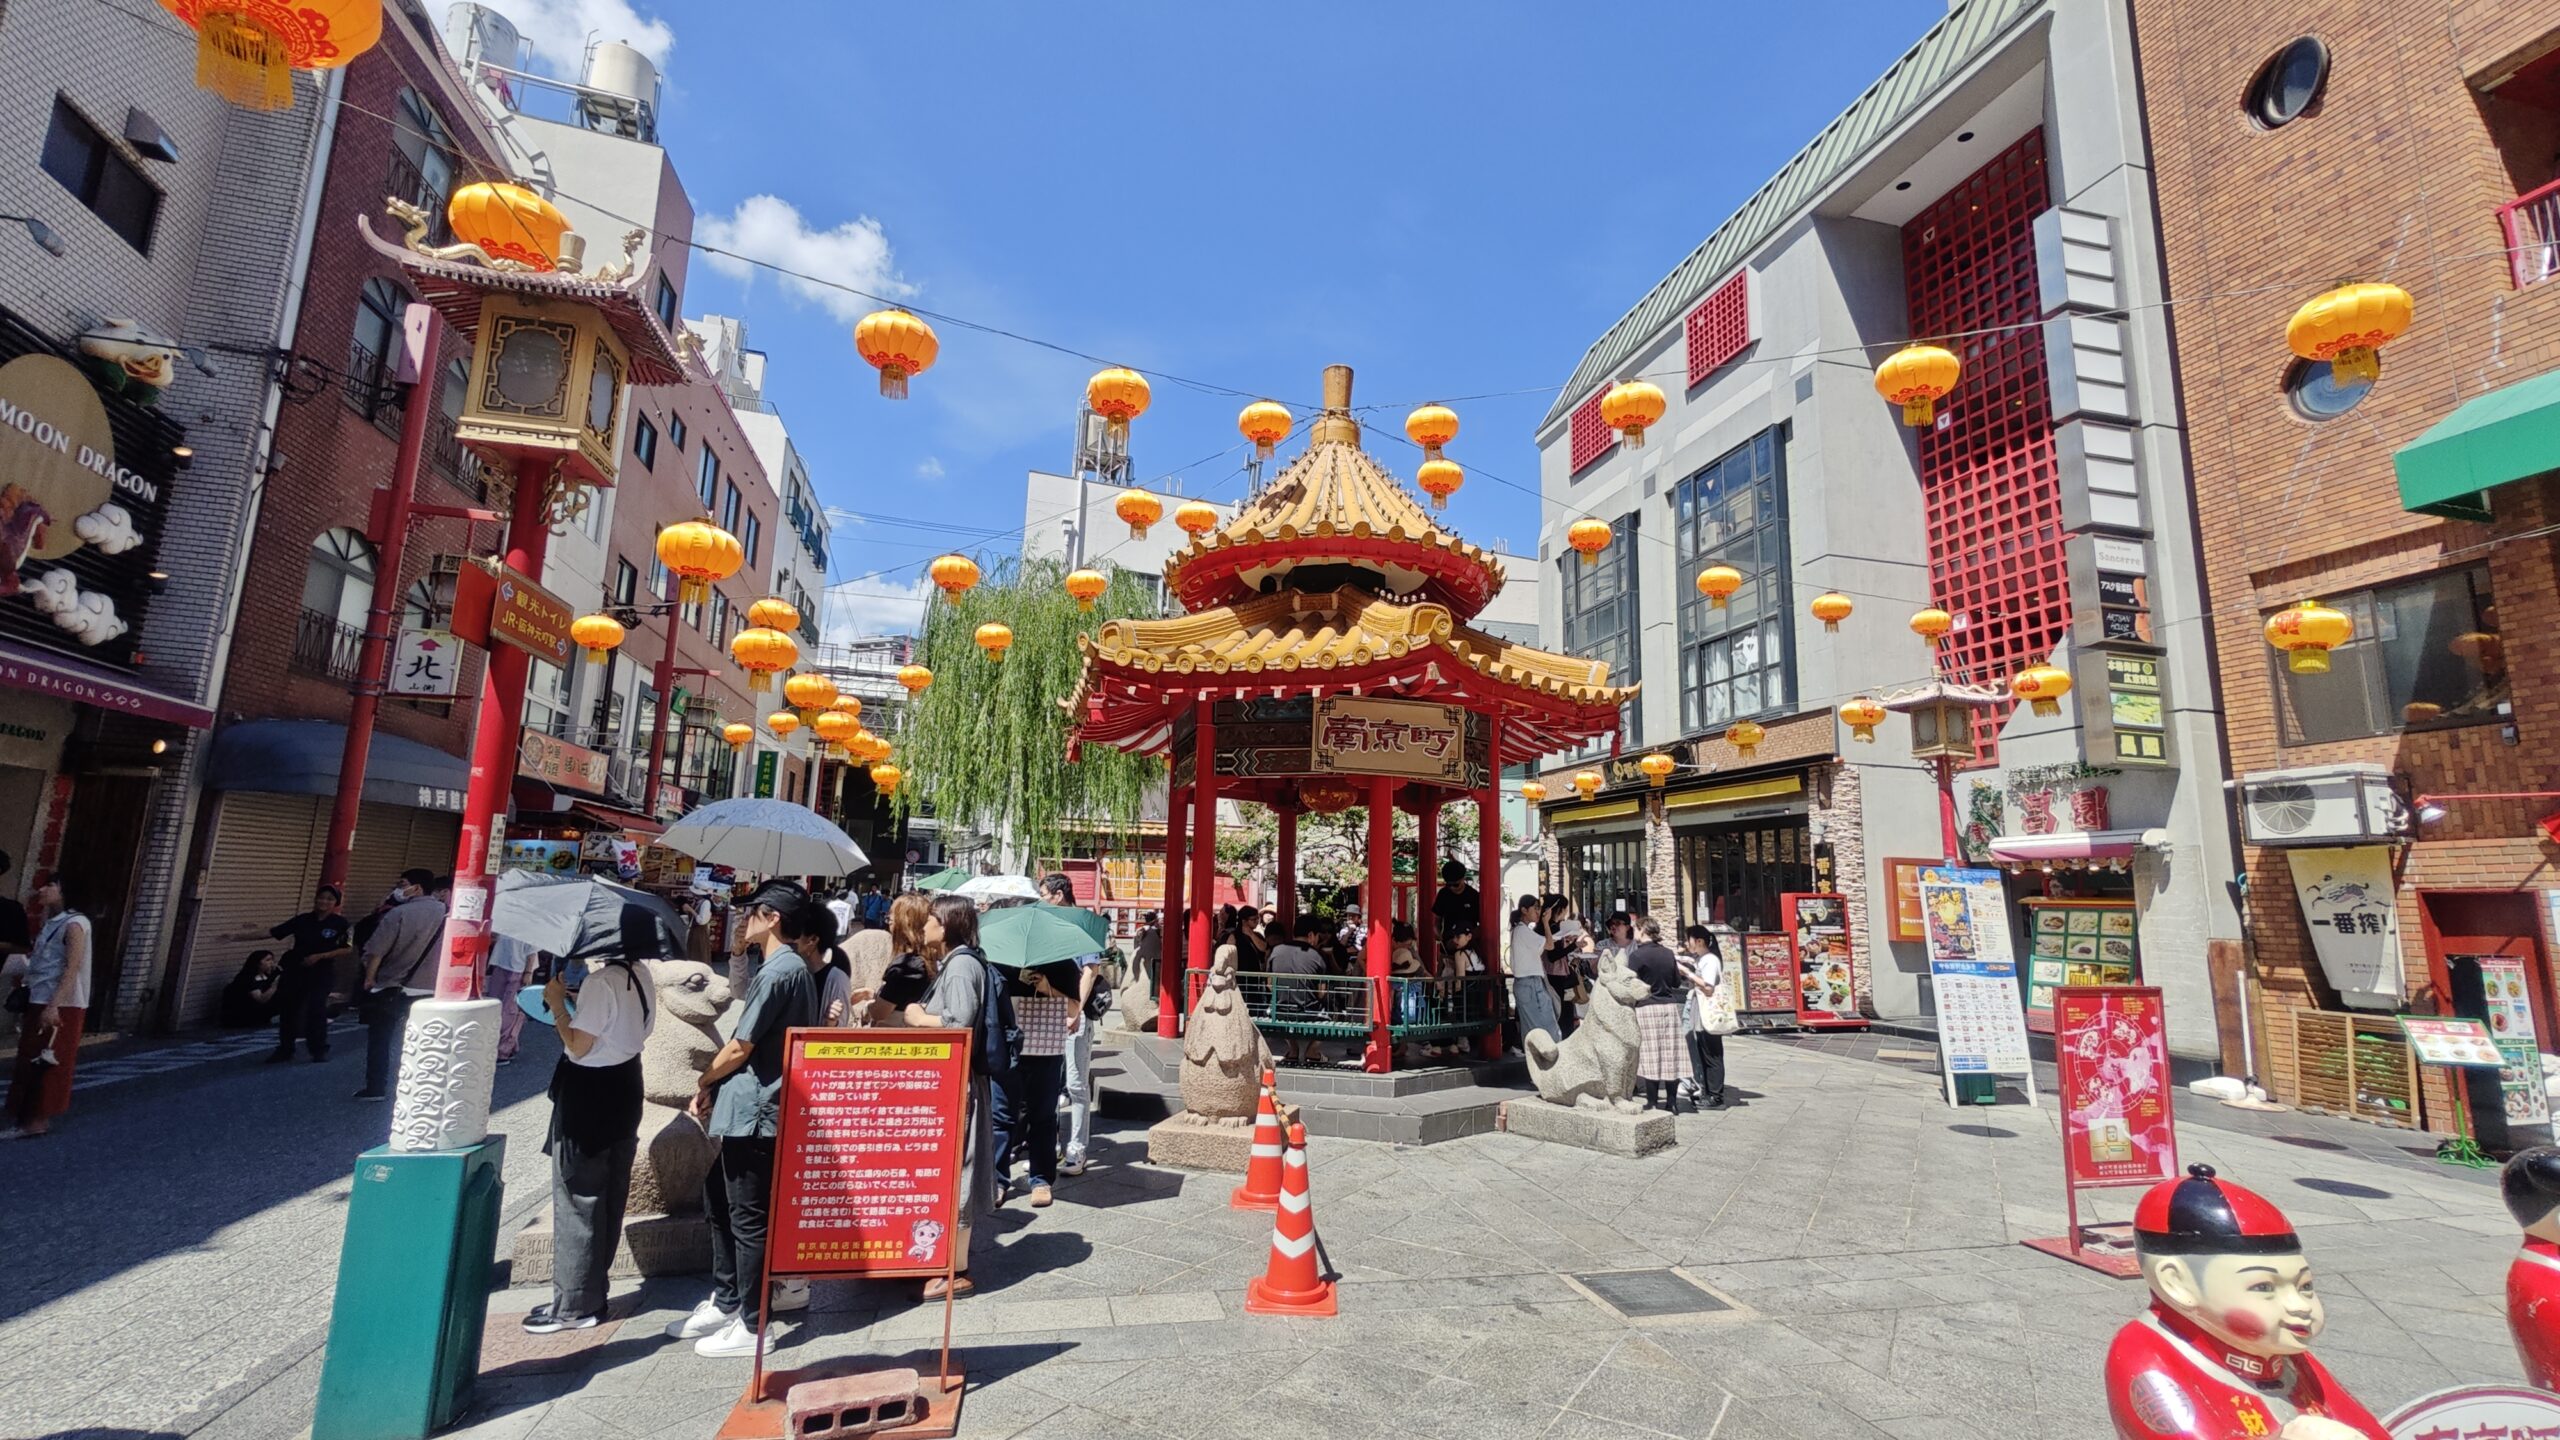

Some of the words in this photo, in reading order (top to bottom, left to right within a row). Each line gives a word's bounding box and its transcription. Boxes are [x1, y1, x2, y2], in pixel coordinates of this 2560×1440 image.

[0, 398, 70, 453] MOON
[77, 444, 157, 502] DRAGON
[516, 590, 566, 629] 観光トイレ
[405, 655, 443, 680] 北
[28, 672, 95, 698] DRAGON
[1321, 714, 1457, 758] 南京町
[817, 1046, 938, 1056] 南京町内禁止事項
[2236, 1408, 2269, 1437] 財
